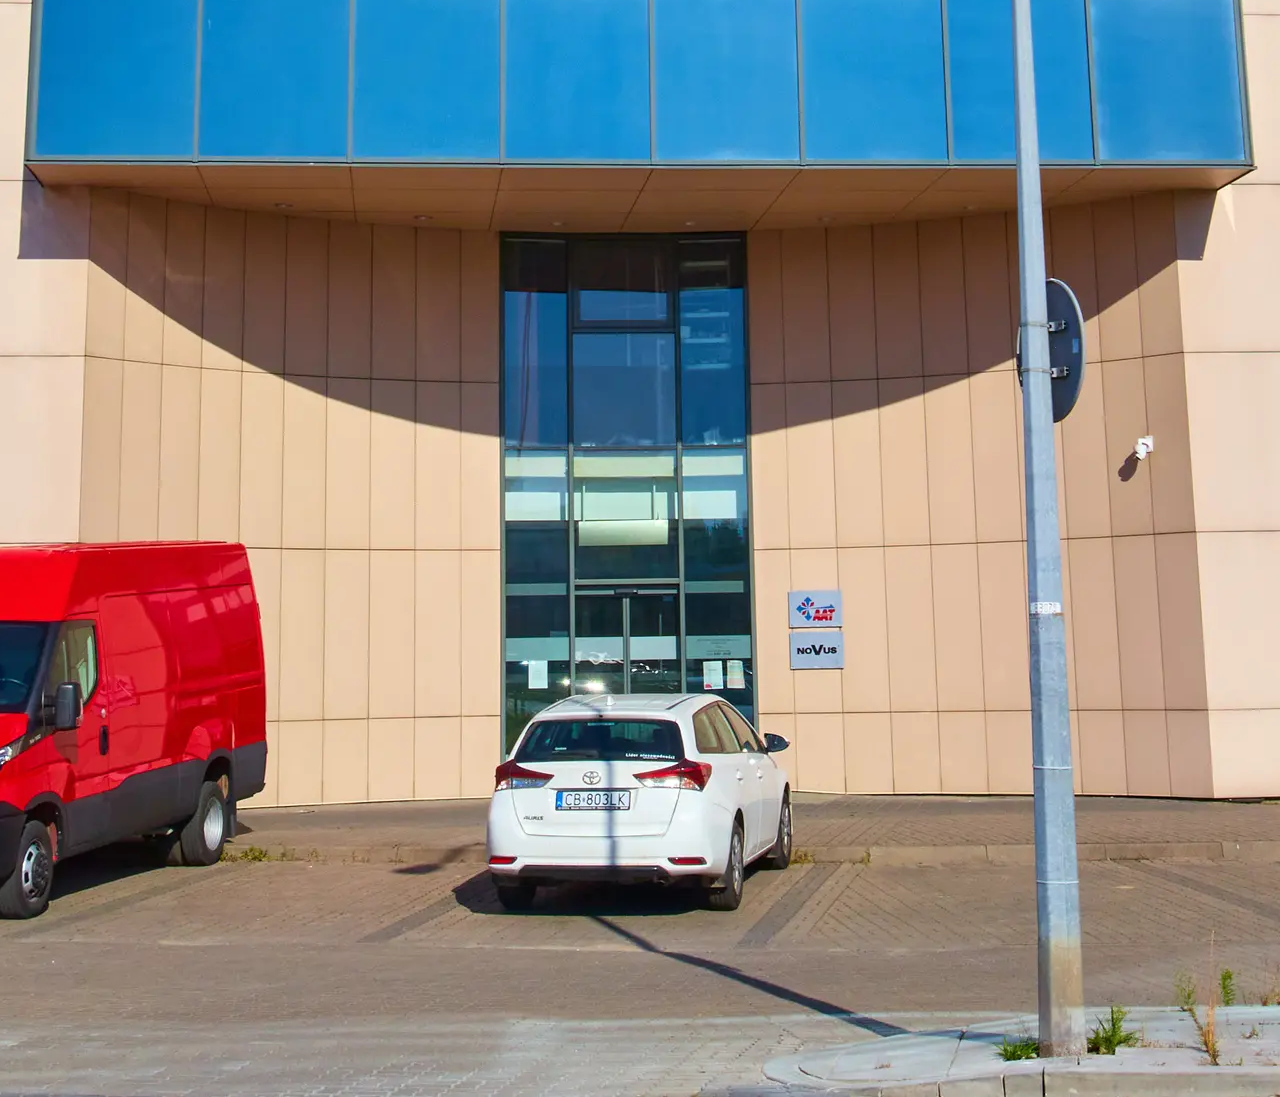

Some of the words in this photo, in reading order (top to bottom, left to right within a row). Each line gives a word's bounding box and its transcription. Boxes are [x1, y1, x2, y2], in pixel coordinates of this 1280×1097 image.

[796, 644, 838, 656] NOVUS
[565, 793, 581, 806] CB
[586, 793, 626, 806] 803LK
